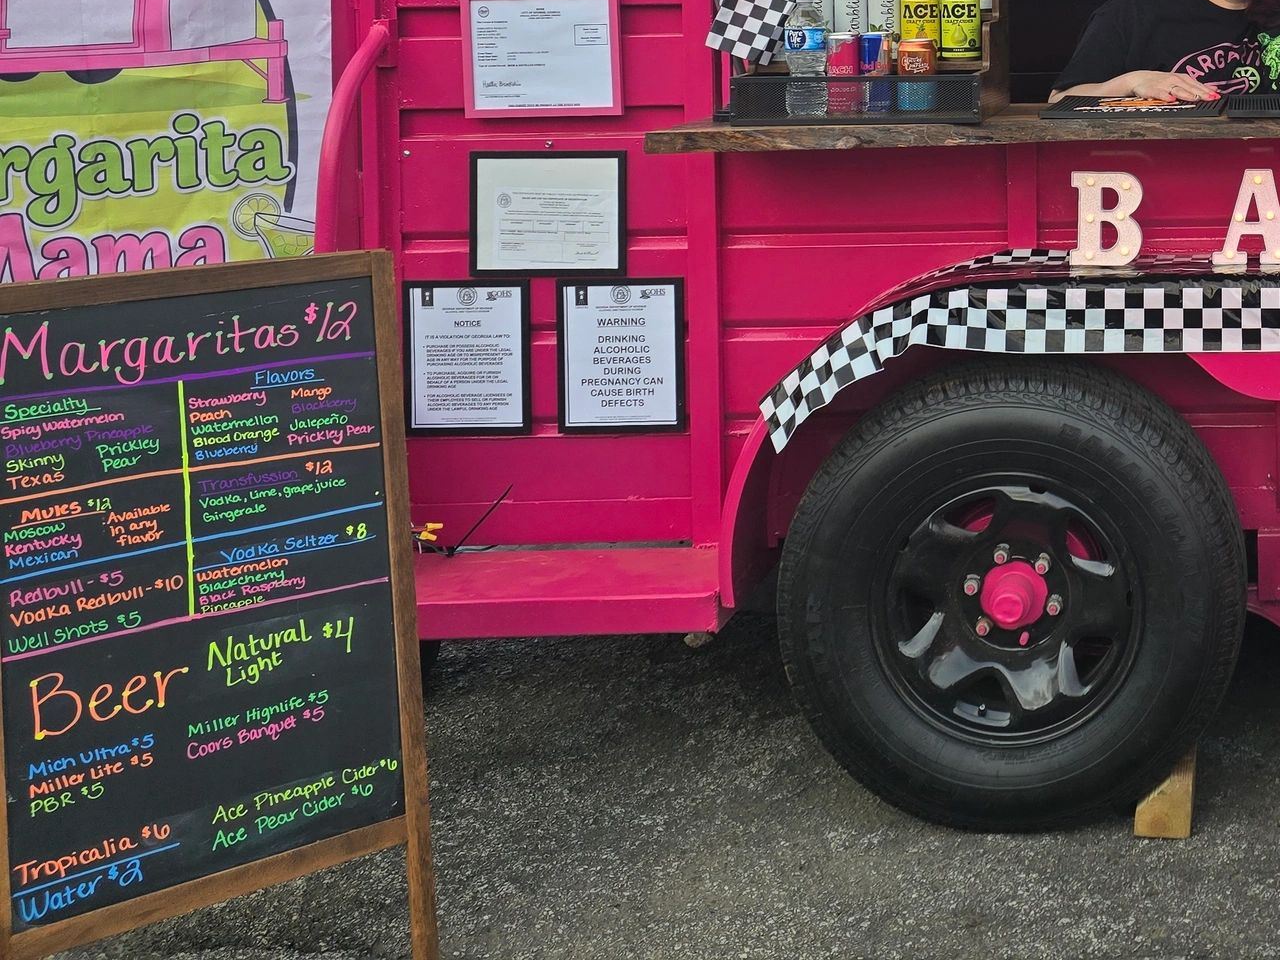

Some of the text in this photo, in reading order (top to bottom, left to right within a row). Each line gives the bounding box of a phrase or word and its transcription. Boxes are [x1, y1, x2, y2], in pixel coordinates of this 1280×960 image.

[902, 3, 939, 19] ACE
[942, 3, 977, 19] ACE
[454, 320, 482, 328] NOTICE
[597, 317, 646, 327] WARNING
[0, 300, 358, 385] Margaritas $12
[593, 345, 650, 354] ALCOHOLIC
[598, 335, 646, 343] DRINKING
[593, 356, 652, 365] BEVERAGES
[603, 367, 641, 375] DURING
[255, 367, 315, 385] Flavors
[581, 377, 664, 387] PREGNANCY CAN
[188, 390, 267, 410] Strawberry
[291, 386, 332, 401] Mango
[590, 388, 655, 397] CAUSE BIRTH
[601, 398, 645, 408] DEFECTS
[4, 396, 88, 421] Specialty
[189, 409, 232, 424] Peach
[1, 413, 125, 441] Spicy Watermelon
[192, 427, 280, 448] Blood Orange
[287, 423, 376, 447] Prickley Pear
[5, 424, 155, 458] Blueberry Pineapple
[95, 438, 161, 459] Prickley
[194, 442, 259, 461] Blueberry
[6, 453, 65, 474] Skinny
[102, 455, 142, 473] Pear
[305, 459, 333, 476] $12
[6, 471, 65, 490] Texas
[21, 497, 113, 523] Mules $12
[107, 504, 171, 525] Available
[203, 503, 267, 523] Gingerale
[4, 522, 65, 543] Moscow
[129, 519, 157, 533] any
[5, 533, 83, 557] Kentucky
[117, 530, 164, 547] flavor
[220, 542, 280, 563] Vodka
[284, 533, 339, 551] Seltzer
[8, 549, 79, 570] Mexican
[196, 557, 289, 583] Watermelon
[99, 570, 125, 587] $5
[198, 591, 237, 606] Black
[200, 594, 266, 616] Pineapple
[10, 604, 71, 628] Vodka
[8, 610, 142, 654] Well Shots $5
[207, 616, 354, 672] Natural $4
[225, 651, 283, 688] Light
[29, 665, 190, 741] Beer
[187, 713, 240, 738] Miller
[307, 689, 330, 705] $5
[186, 705, 326, 760] Coors Banquet $5
[28, 734, 155, 780] Mich Ultra $5
[29, 752, 154, 799] Miller Lite $5
[29, 781, 105, 818] PBR $5
[212, 758, 398, 825] Ace Pineapple Cider $6
[212, 783, 374, 852] Ace Pear Cider $6
[13, 823, 171, 886] Tropicalia $6
[19, 858, 144, 923] Water $2
